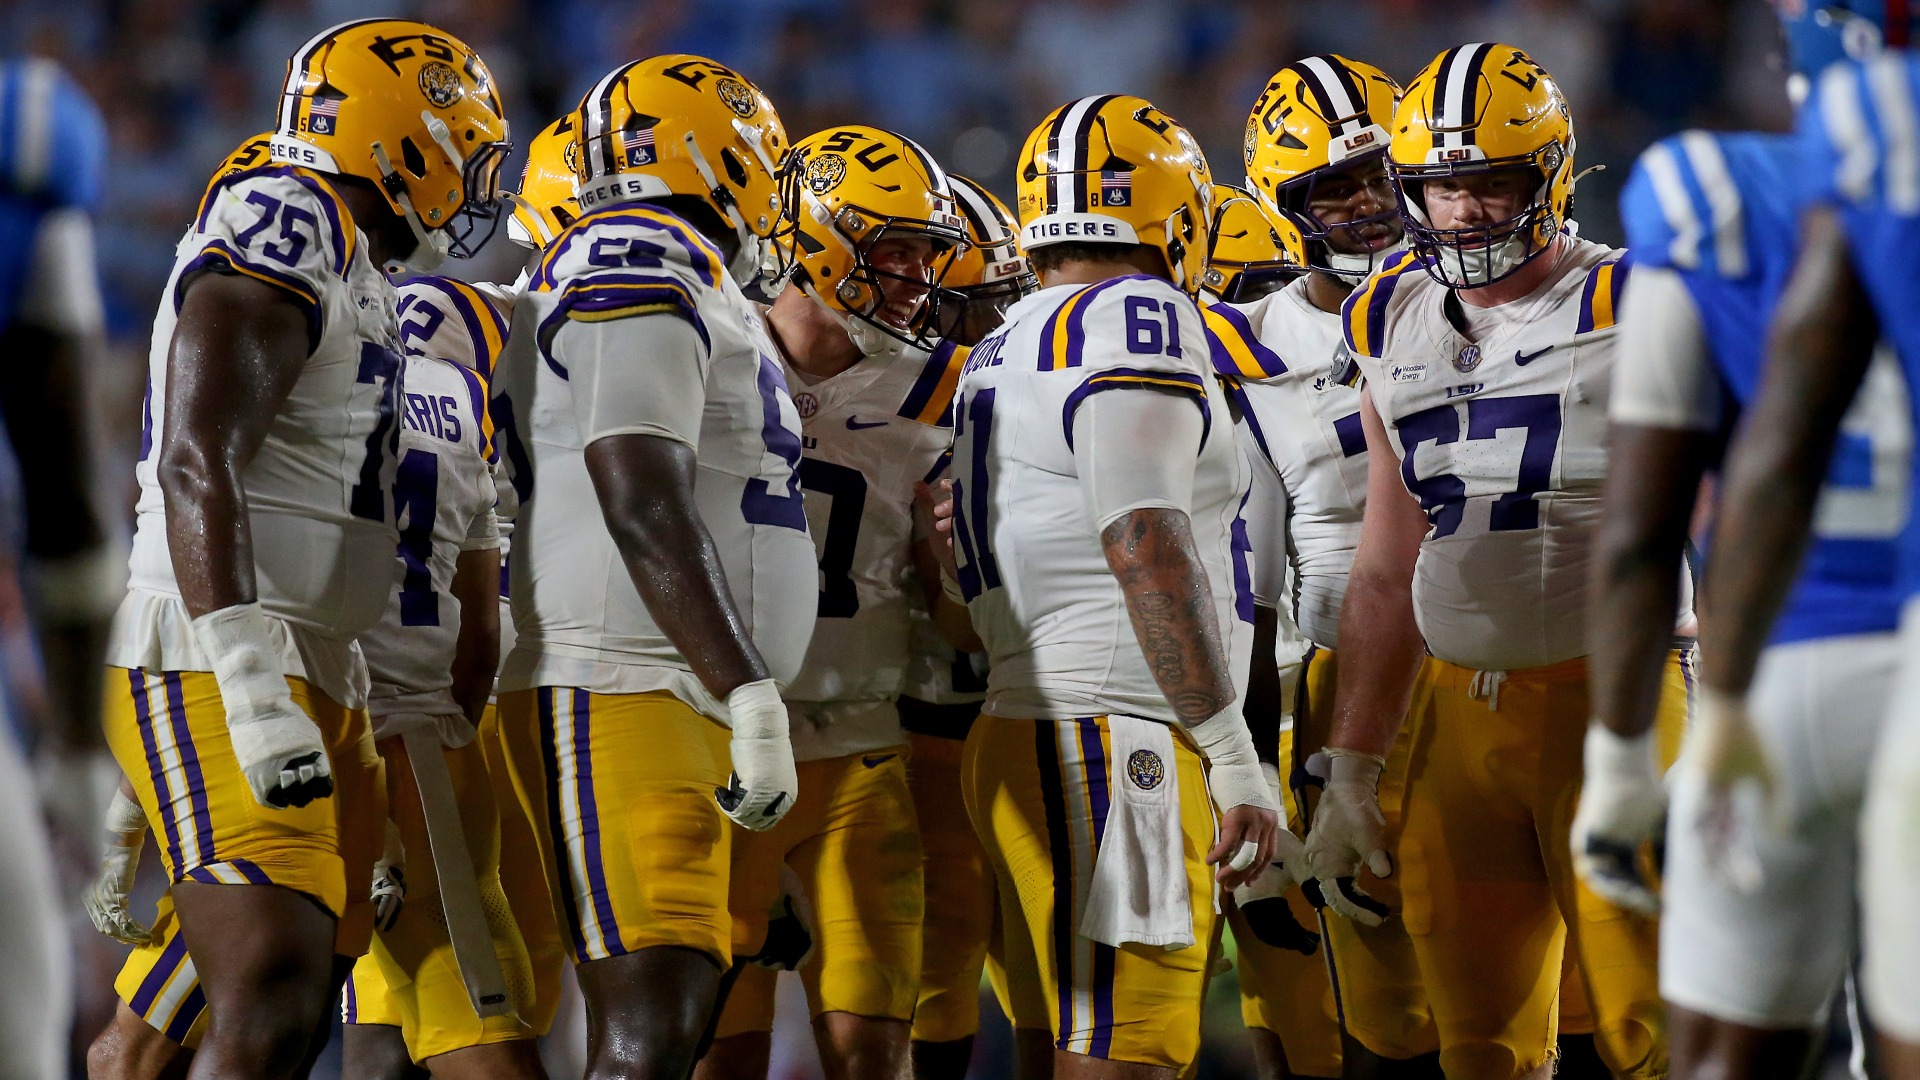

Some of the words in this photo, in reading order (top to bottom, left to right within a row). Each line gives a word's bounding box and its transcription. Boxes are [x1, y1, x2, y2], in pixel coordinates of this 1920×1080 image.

[1344, 131, 1375, 151] LSU
[1437, 149, 1471, 163] LSU
[578, 181, 642, 211] TIGERS
[1091, 193, 1098, 206] 8
[235, 191, 316, 267] 75
[1030, 222, 1117, 239] TIGERS
[1124, 295, 1183, 360] 61
[1403, 363, 1427, 371] Woodside
[1402, 373, 1420, 381] Energy
[1446, 383, 1484, 398] LSU
[1393, 393, 1561, 541] 67
